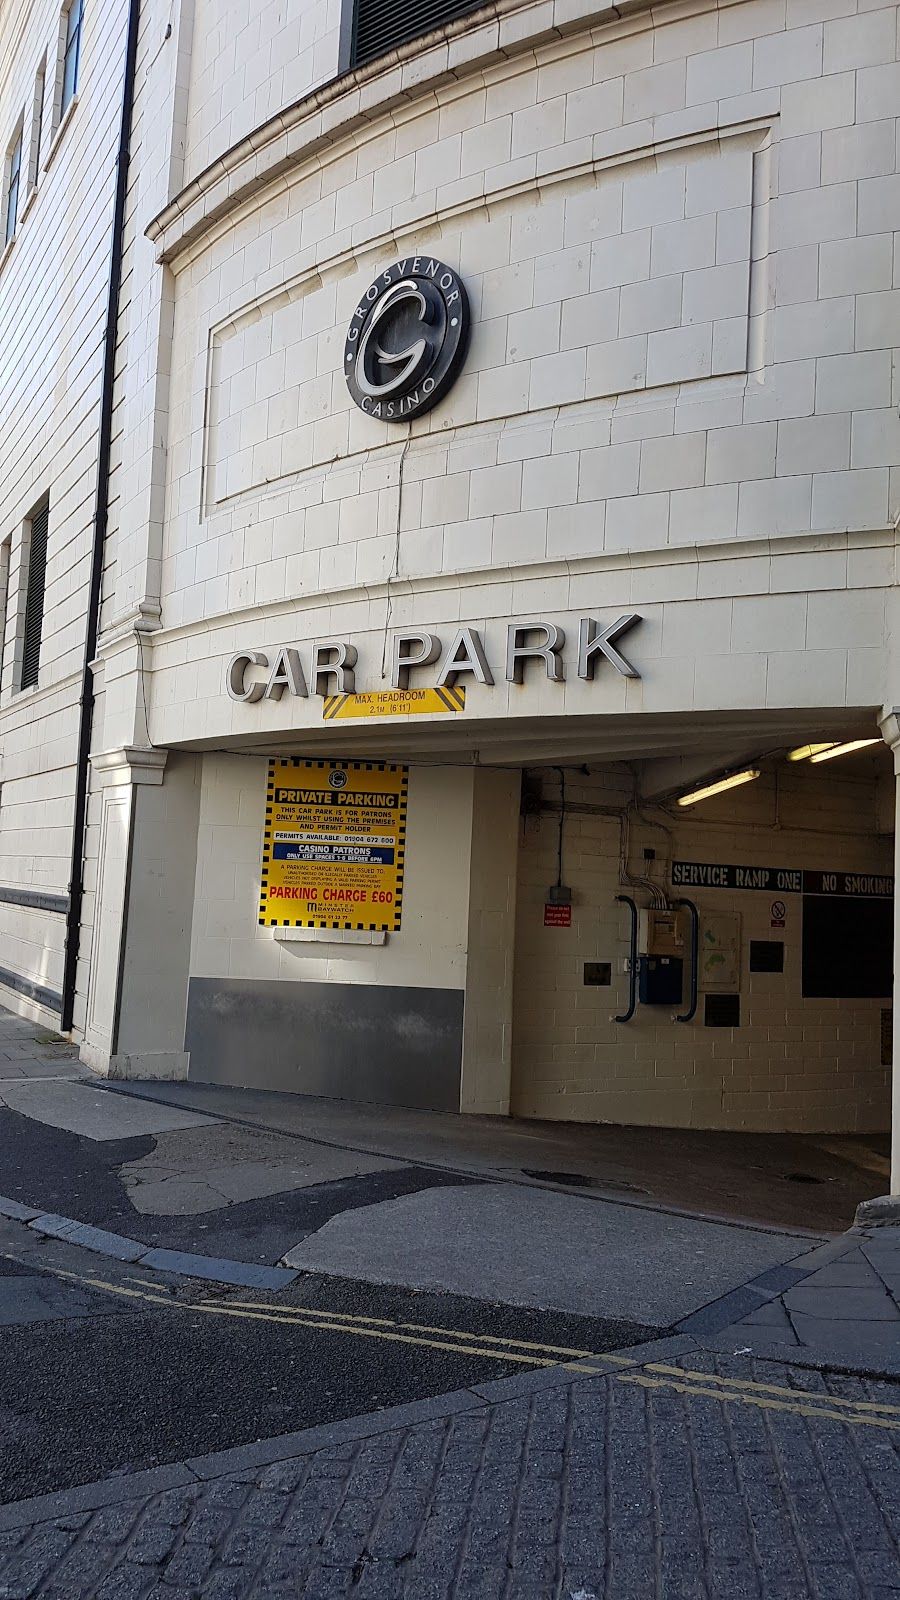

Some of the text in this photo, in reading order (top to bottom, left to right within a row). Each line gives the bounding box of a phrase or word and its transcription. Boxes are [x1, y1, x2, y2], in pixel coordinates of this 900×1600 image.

[348, 258, 459, 341] GROSVENOR
[361, 377, 435, 417] CASINO
[226, 614, 643, 703] CAR PARK
[355, 691, 426, 704] MAX. HEADROOM
[279, 790, 395, 807] PRIVATE PARKING
[299, 845, 371, 855] CASINO PATRONS
[674, 864, 801, 890] SERVICE RAMP ONE
[822, 874, 894, 895] NO SMOKING
[270, 886, 393, 904] PARKING CHARGE £60
